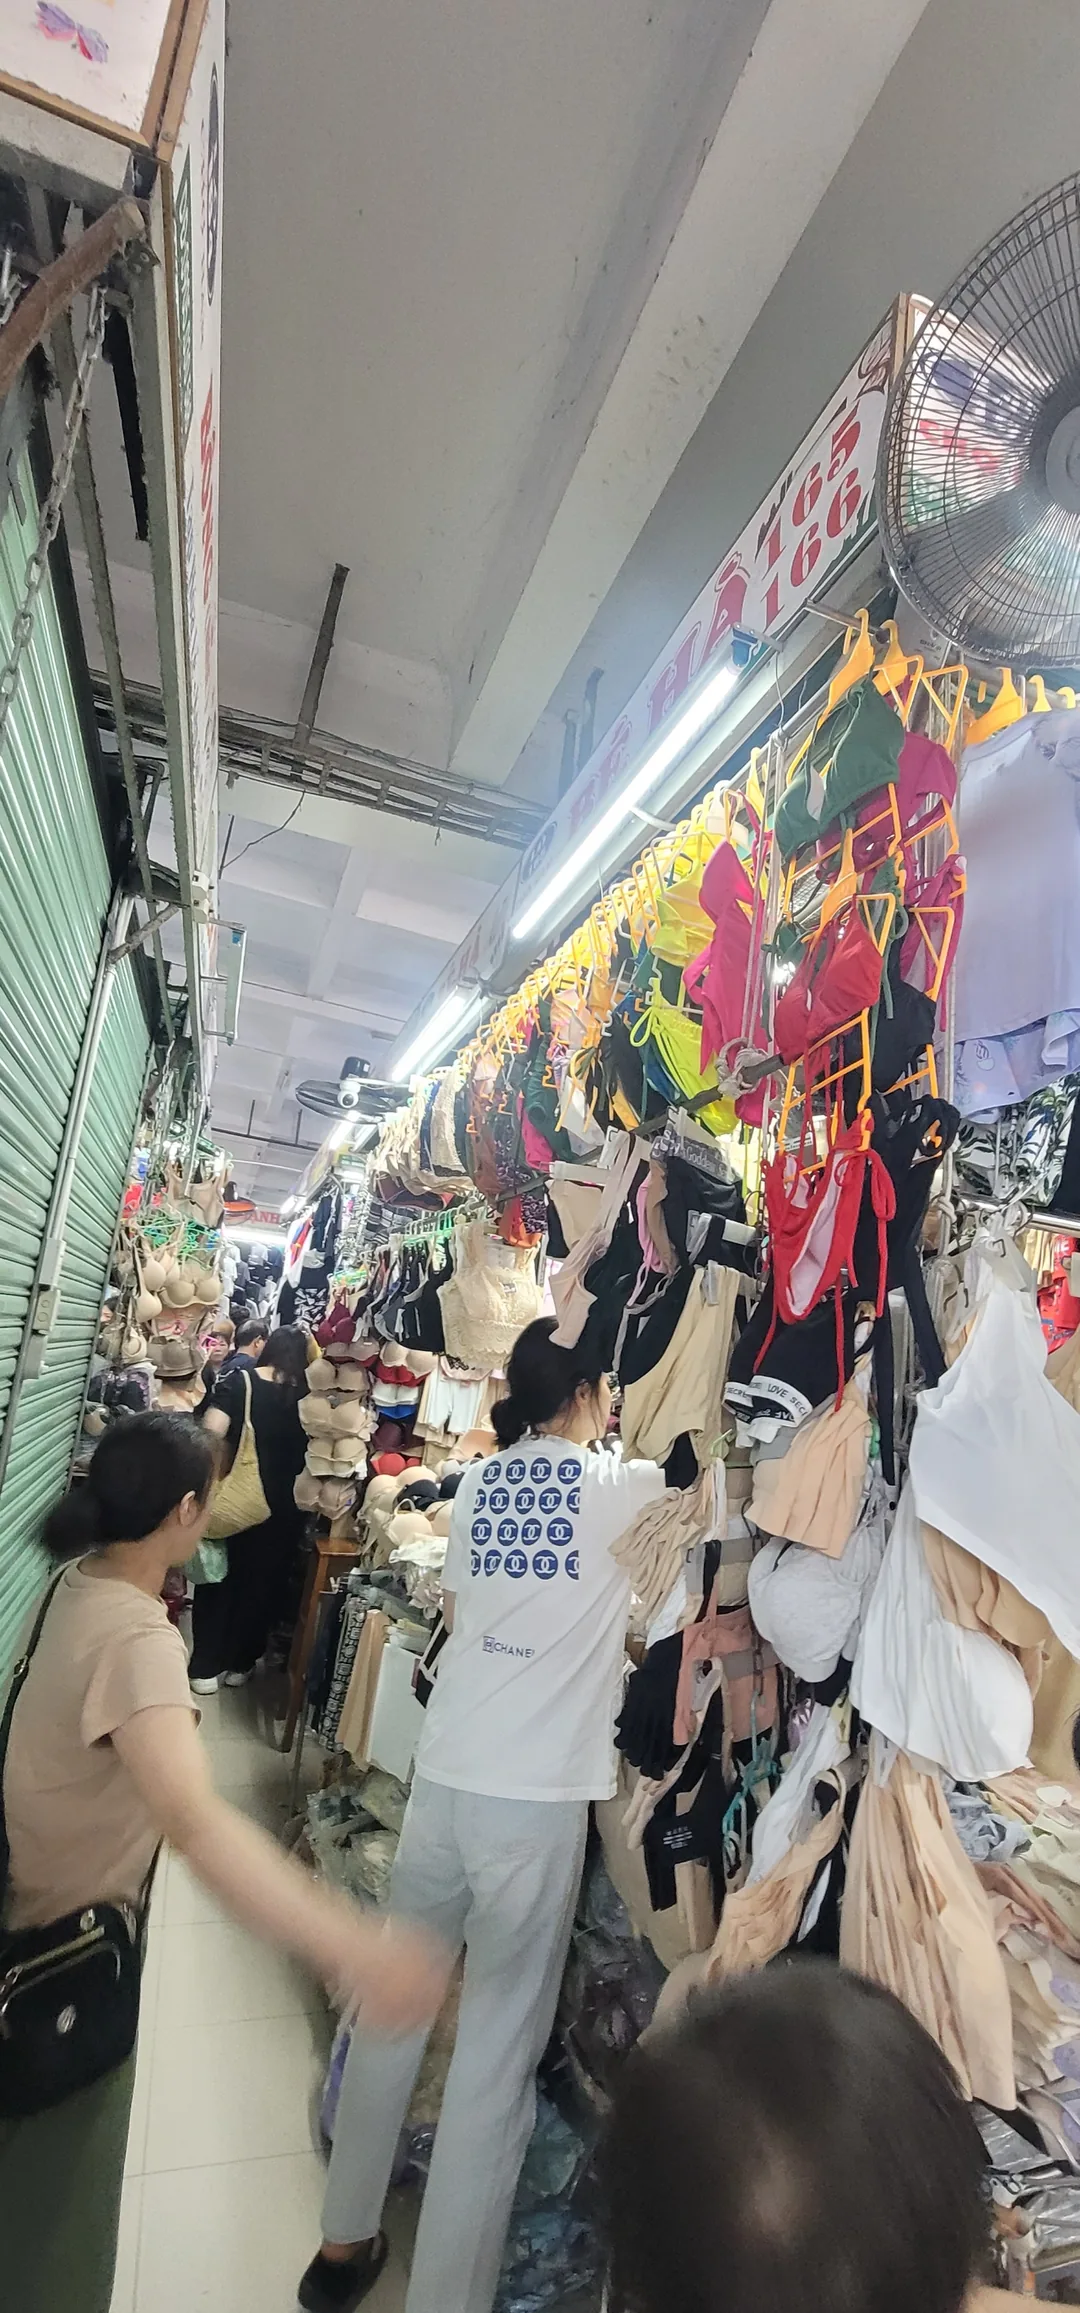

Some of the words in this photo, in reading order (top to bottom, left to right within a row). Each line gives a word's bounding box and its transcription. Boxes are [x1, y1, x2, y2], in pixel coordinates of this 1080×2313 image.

[761, 399, 861, 581] 165
[761, 467, 862, 635] 166
[767, 1383, 789, 1398] LOVE
[494, 1642, 535, 1658] CHANE
